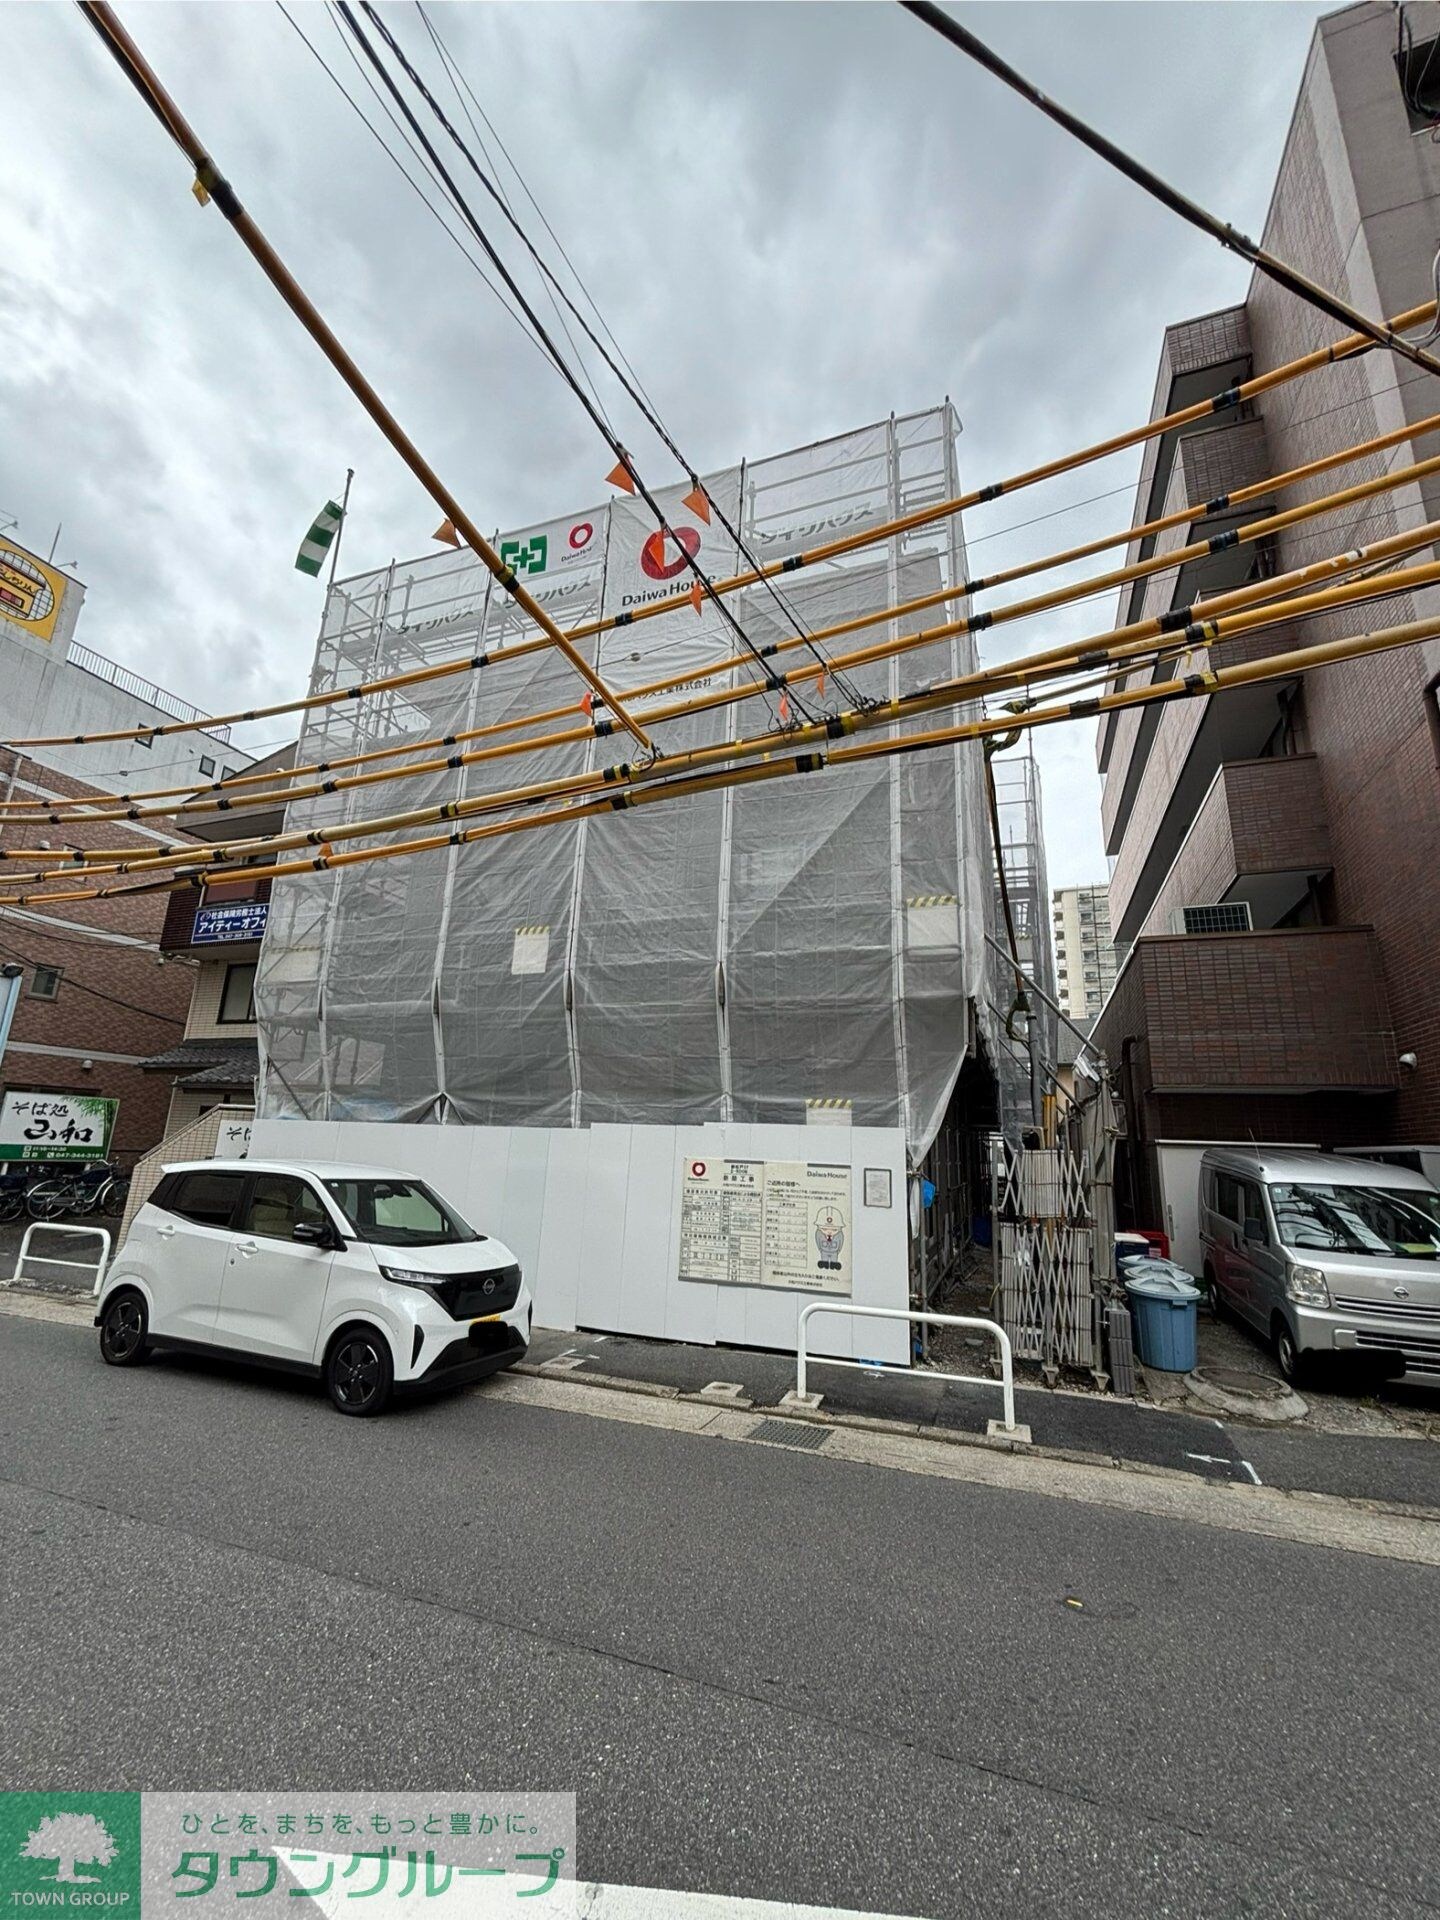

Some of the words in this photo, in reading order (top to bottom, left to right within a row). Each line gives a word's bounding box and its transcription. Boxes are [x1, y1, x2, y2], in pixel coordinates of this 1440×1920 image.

[622, 588, 667, 607] Daiwa
[11, 1101, 69, 1117] そば処
